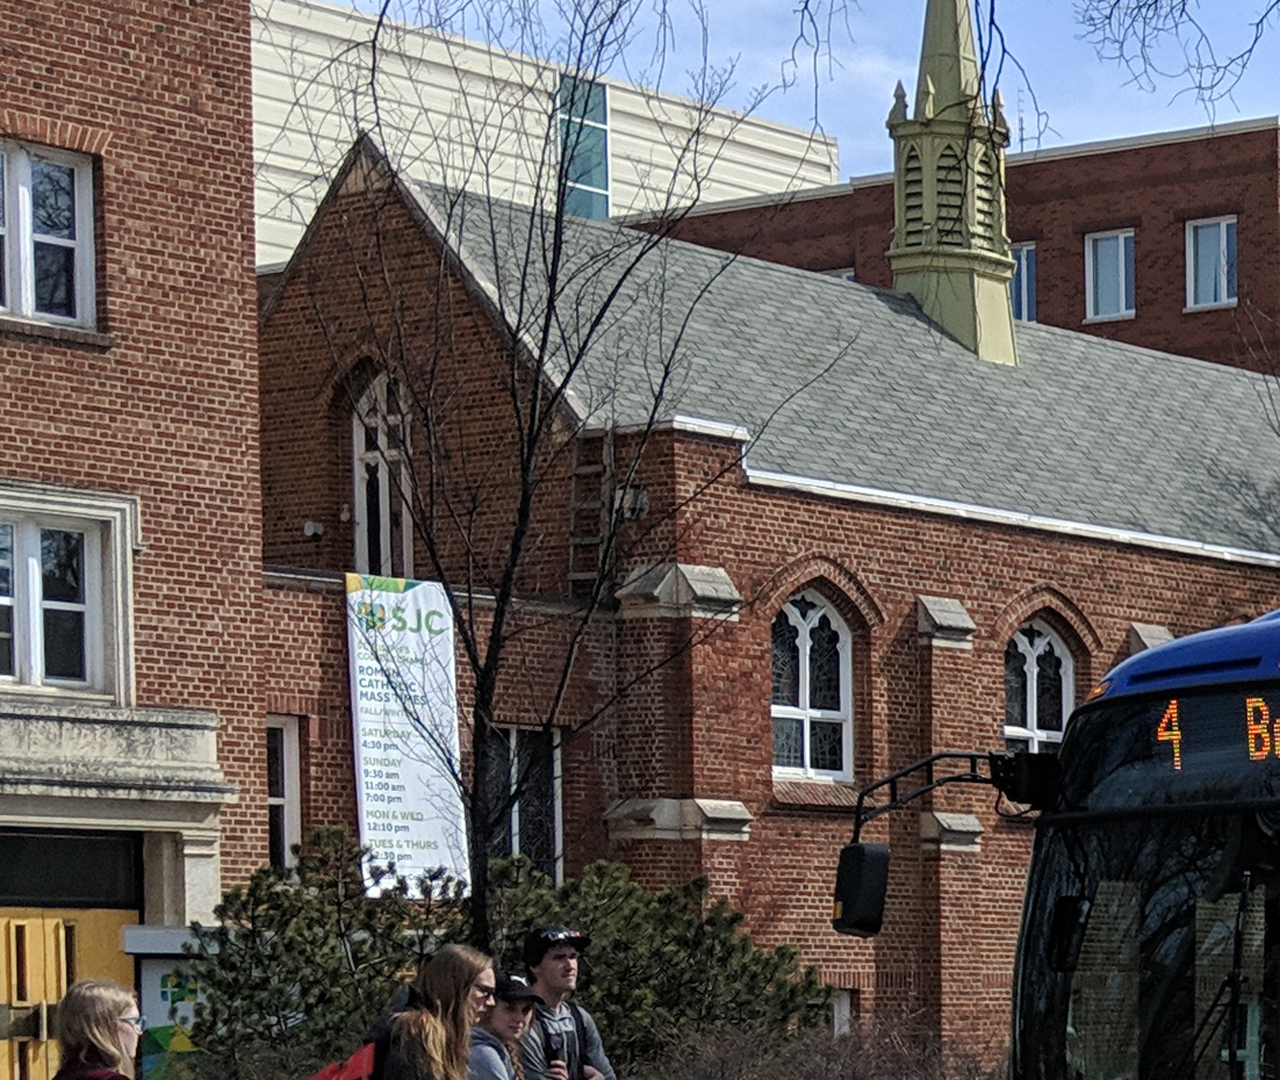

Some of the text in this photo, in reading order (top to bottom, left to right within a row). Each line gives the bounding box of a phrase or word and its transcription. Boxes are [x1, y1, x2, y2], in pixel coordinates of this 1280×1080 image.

[391, 605, 444, 635] SJC
[359, 678, 417, 693] CATHOLC
[359, 691, 391, 703] MASS
[361, 727, 411, 739] SATURDAY
[1157, 699, 1181, 770] 4
[362, 740, 399, 752] 4:30 pm
[363, 757, 403, 767] SUNDAY
[363, 769, 384, 779] 9:30
[365, 781, 406, 792] 11:00 am
[365, 793, 403, 805] 7:00 pm
[366, 809, 424, 821] MON & WED
[367, 822, 410, 834] 12:10 pm
[369, 839, 438, 850] TUES & THURS
[372, 851, 412, 862] 2:30 pm
